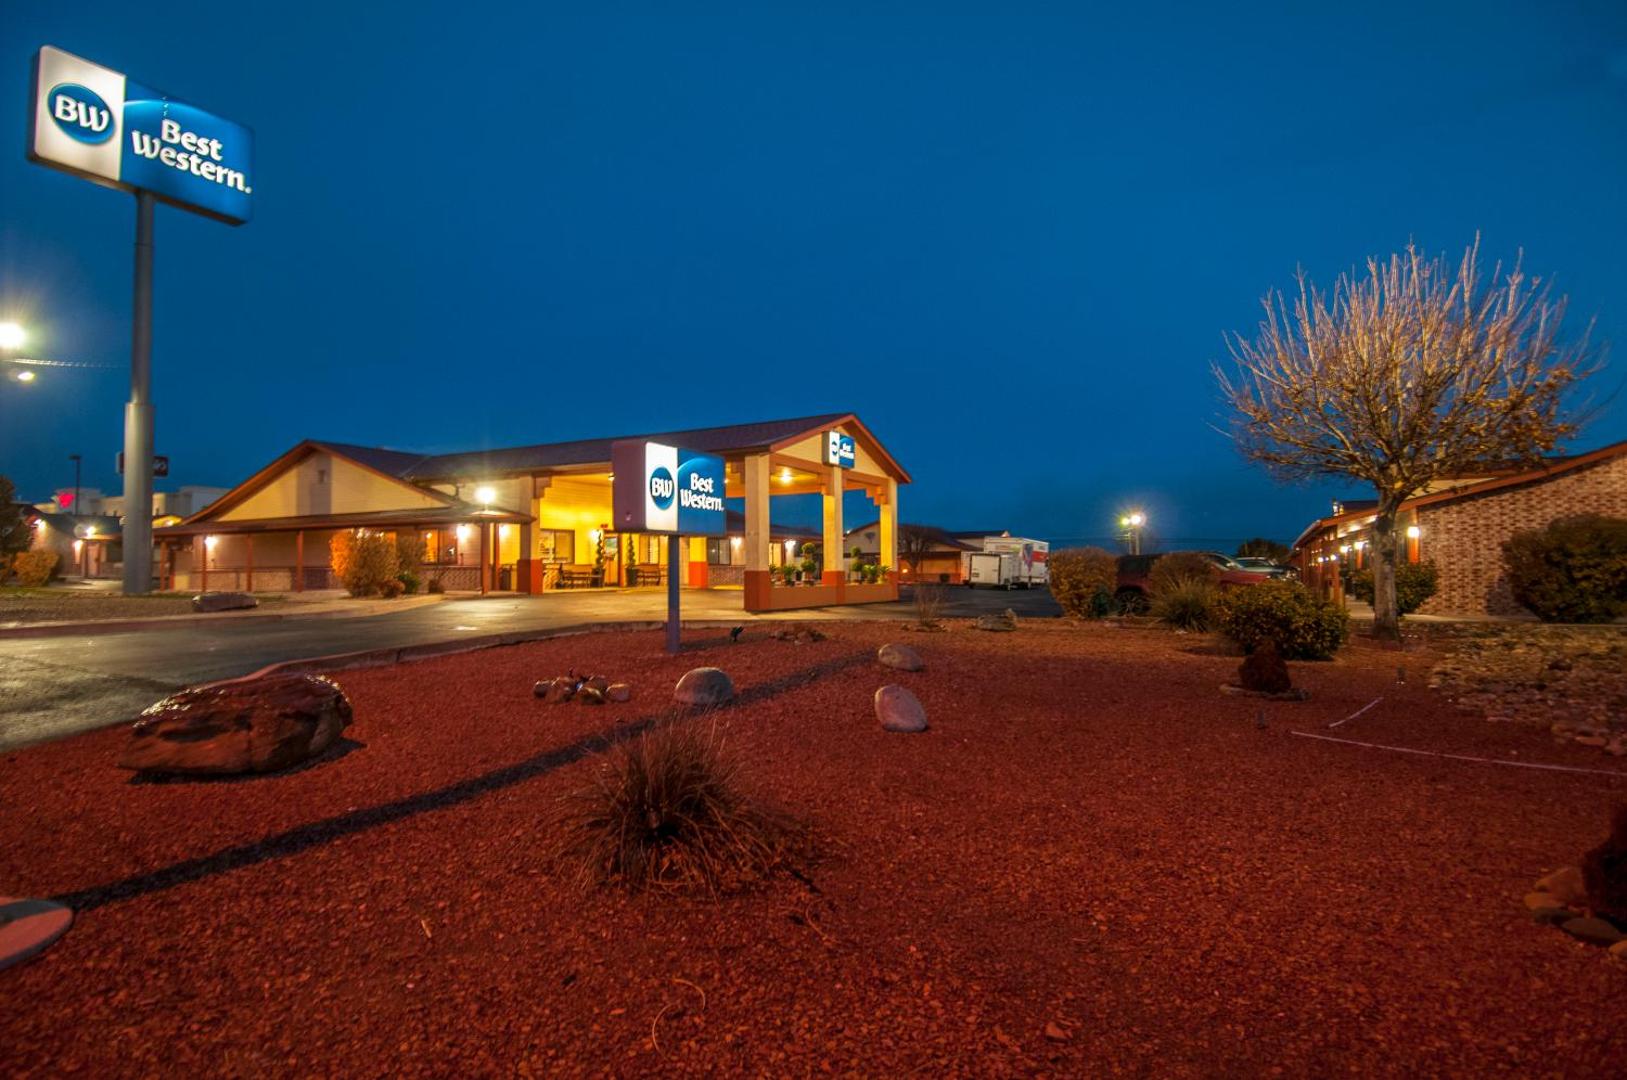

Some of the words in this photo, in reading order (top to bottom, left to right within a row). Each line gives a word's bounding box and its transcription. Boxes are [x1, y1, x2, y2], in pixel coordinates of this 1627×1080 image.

[55, 94, 109, 132] BW
[161, 118, 223, 161] Best
[651, 477, 673, 498] BW
[690, 473, 714, 493] Best
